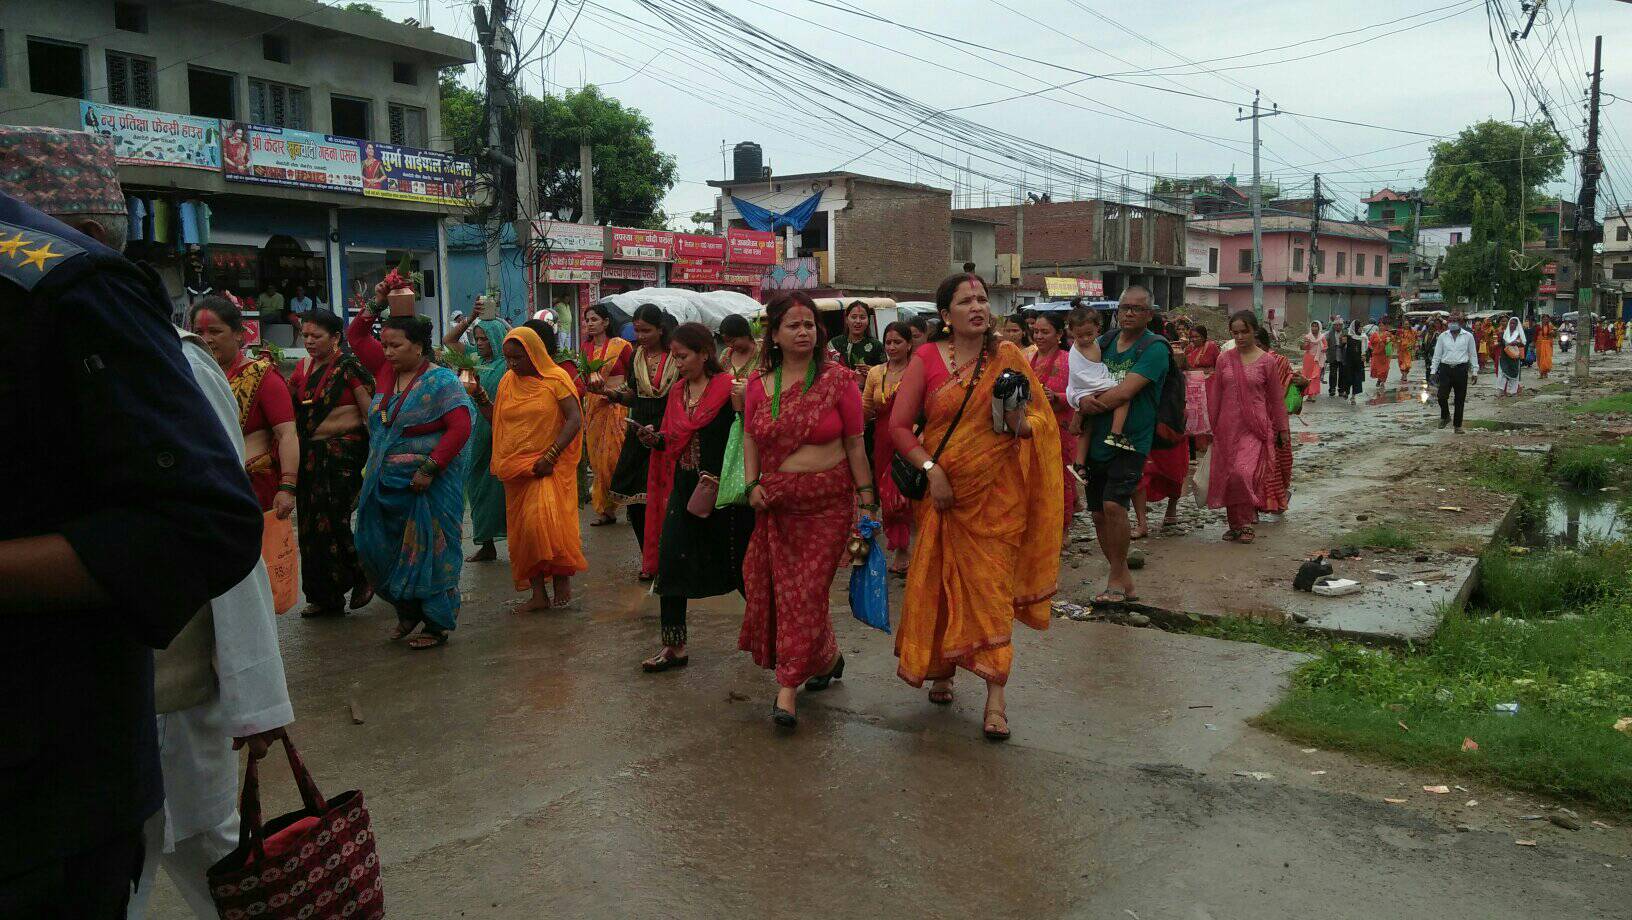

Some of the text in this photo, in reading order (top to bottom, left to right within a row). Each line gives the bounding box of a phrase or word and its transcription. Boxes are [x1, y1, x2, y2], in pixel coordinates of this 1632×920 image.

[101, 114, 118, 132] न्यू
[252, 132, 262, 151] श्री
[264, 134, 285, 155] केदार
[340, 149, 357, 164] पसल
